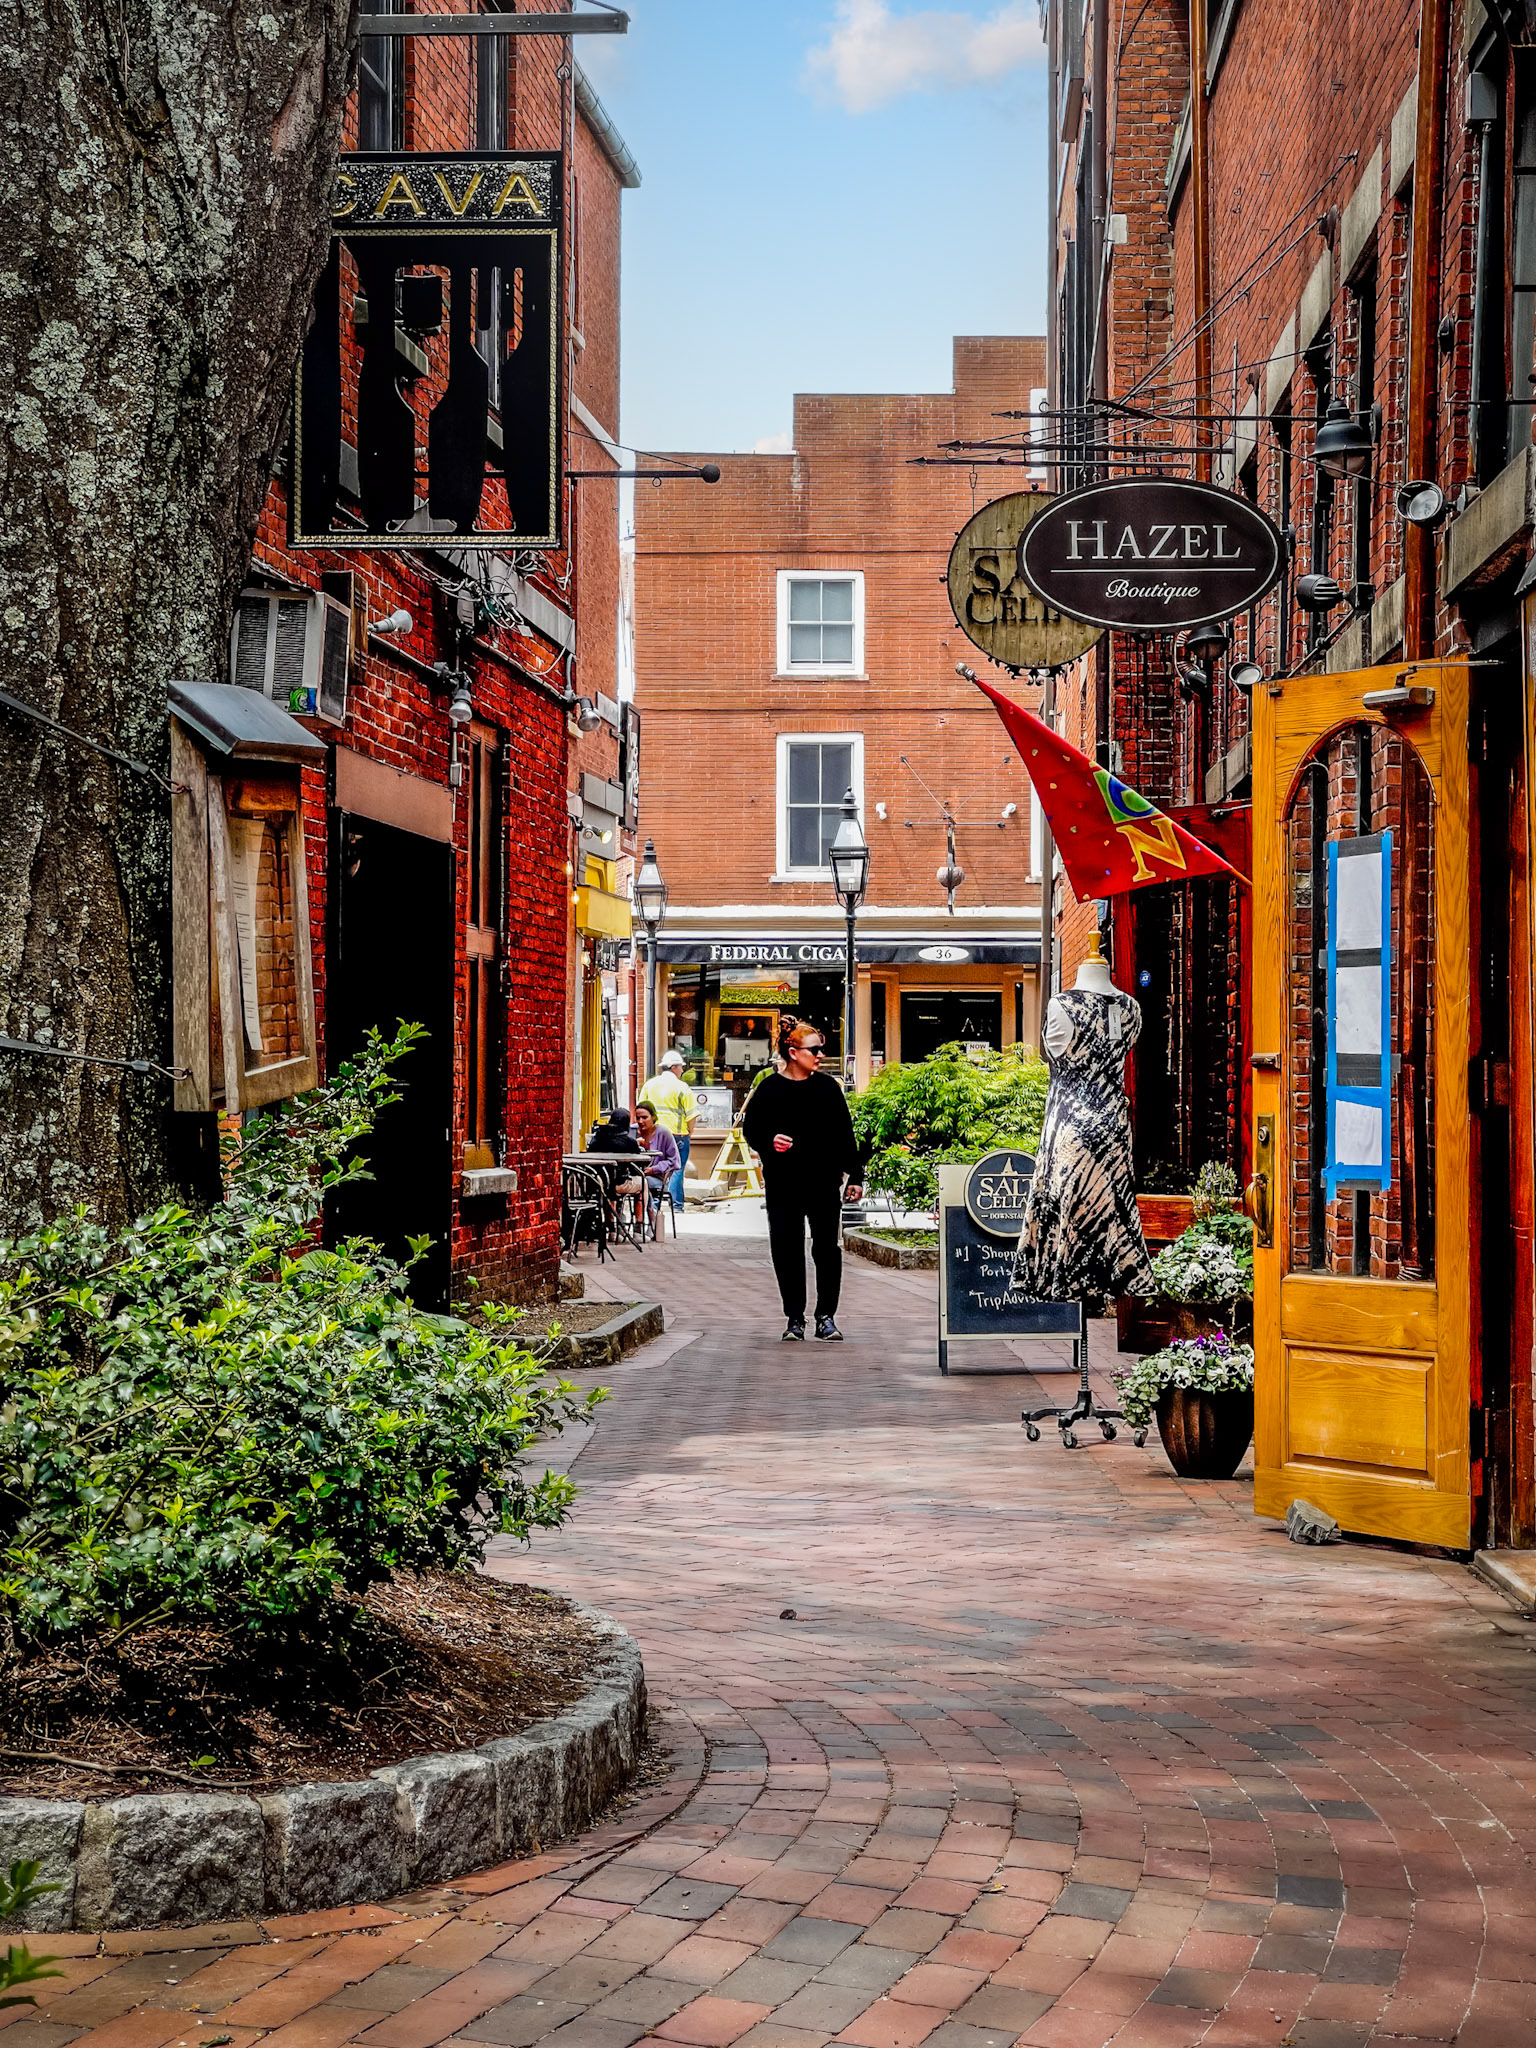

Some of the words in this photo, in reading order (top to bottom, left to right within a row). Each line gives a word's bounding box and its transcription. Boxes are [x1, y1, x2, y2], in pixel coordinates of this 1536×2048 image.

[332, 171, 545, 217] CAVA
[1066, 520, 1241, 560] HAZEL
[1105, 578, 1201, 605] Boutique
[710, 945, 793, 961] FEDERAL
[935, 949, 952, 959] 36
